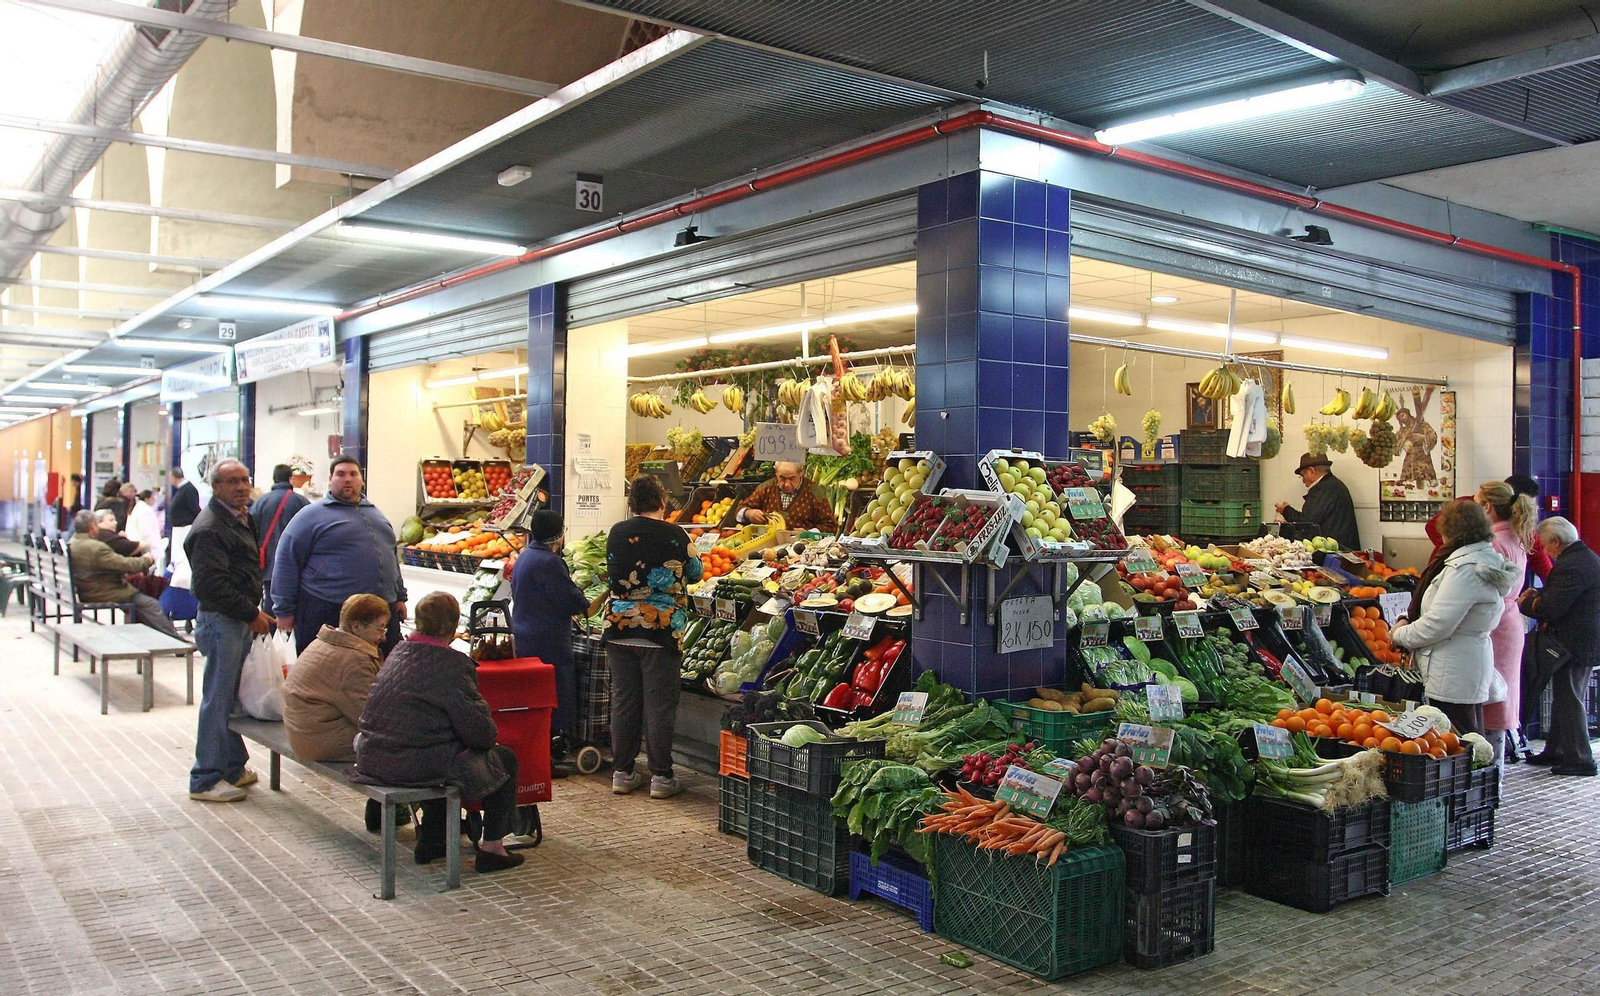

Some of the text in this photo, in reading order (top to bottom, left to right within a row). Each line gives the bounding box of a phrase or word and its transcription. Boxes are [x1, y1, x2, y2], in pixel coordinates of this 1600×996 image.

[579, 189, 601, 210] 30
[221, 327, 235, 338] 29
[578, 495, 600, 503] PORTES
[1120, 725, 1151, 738] Frutas
[1007, 767, 1038, 785] Frutas
